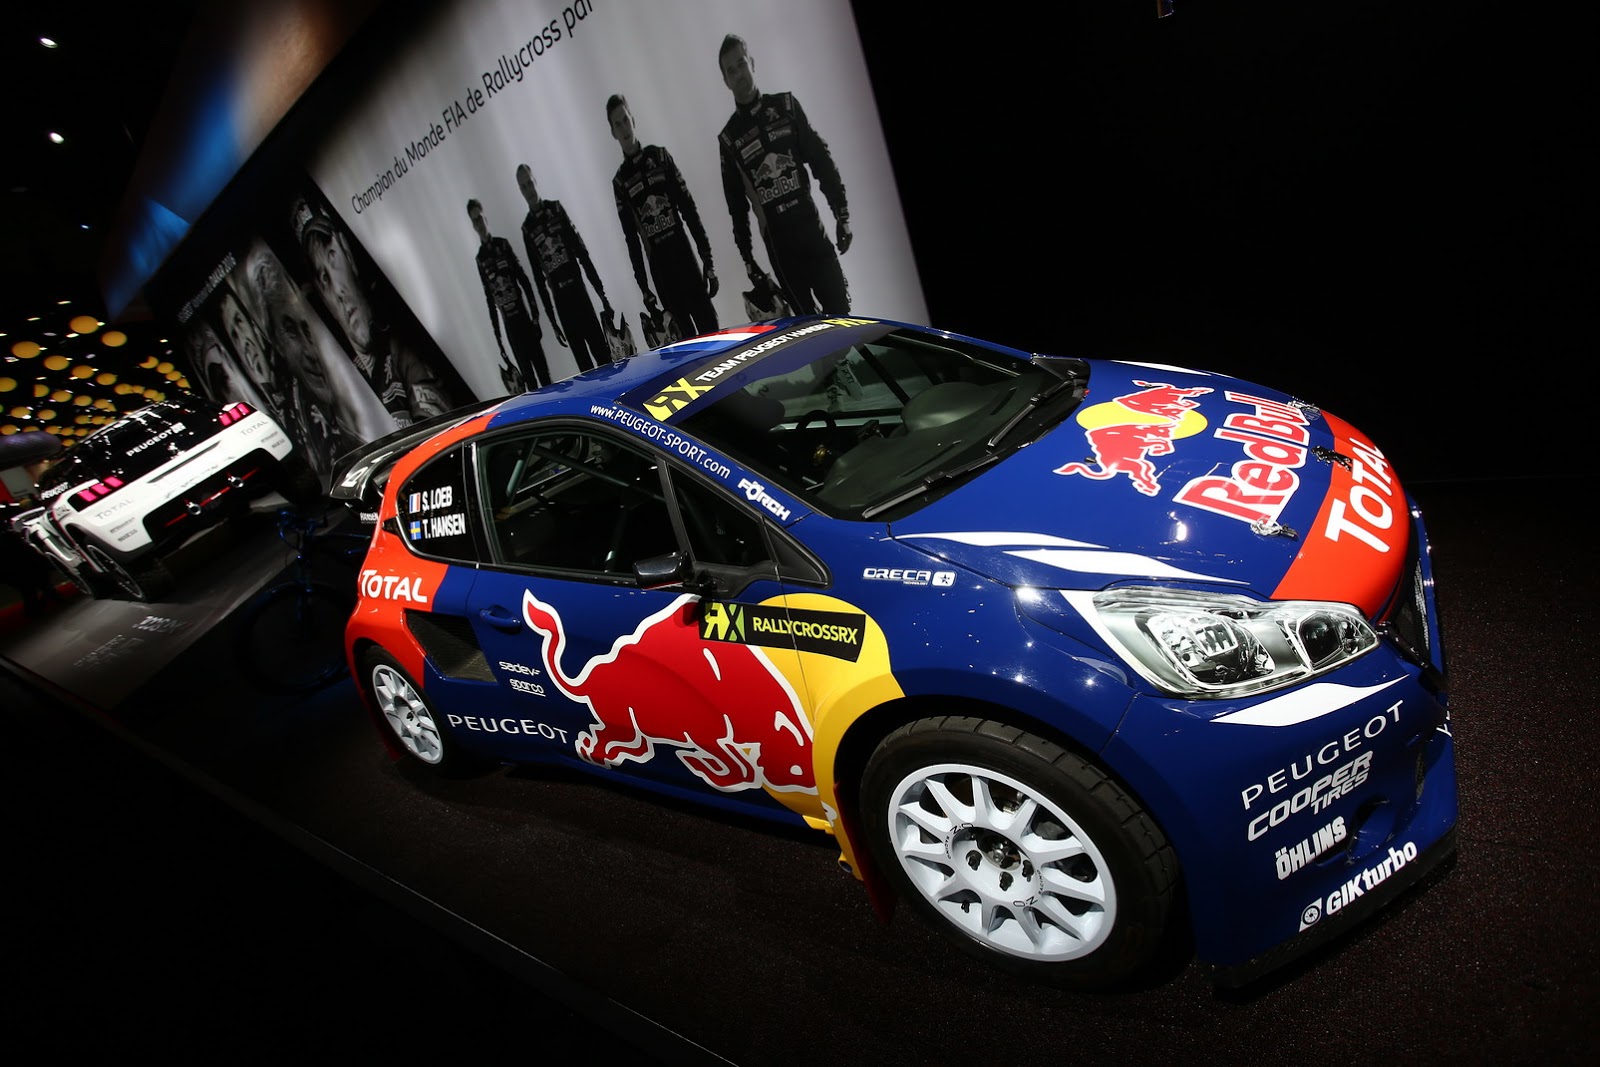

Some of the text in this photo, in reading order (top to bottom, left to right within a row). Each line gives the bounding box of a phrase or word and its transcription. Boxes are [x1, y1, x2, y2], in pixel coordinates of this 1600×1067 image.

[351, 169, 396, 214] Champion
[394, 156, 409, 179] du
[405, 123, 446, 167] Monde
[442, 101, 468, 134] FIA
[466, 88, 485, 114] de
[482, 19, 562, 98] Rallycross
[695, 322, 835, 382] TEAM PEUGEOT HANSEN
[126, 429, 172, 457] PEUGEOT
[241, 420, 268, 436] TOTAL
[590, 404, 731, 479] www.PEUGEOT-SPORT.com
[1172, 428, 1308, 528] Red
[1324, 437, 1394, 553] TOTAL
[95, 499, 134, 520] TOTAL
[422, 485, 453, 511] S. LOEB
[737, 477, 791, 521] FÖRCH
[431, 513, 466, 538] HANSEN
[361, 569, 428, 602] TOTAL
[863, 568, 932, 581] ORECA
[752, 616, 858, 645] RALLYCROSSRX
[510, 679, 545, 695] sparco
[447, 713, 568, 743] PEUGEOT
[1241, 700, 1403, 810] PEUGEOT
[1247, 751, 1373, 841] COOPER
[1310, 768, 1370, 815] TIRES
[1275, 816, 1346, 880] ÖHLINS
